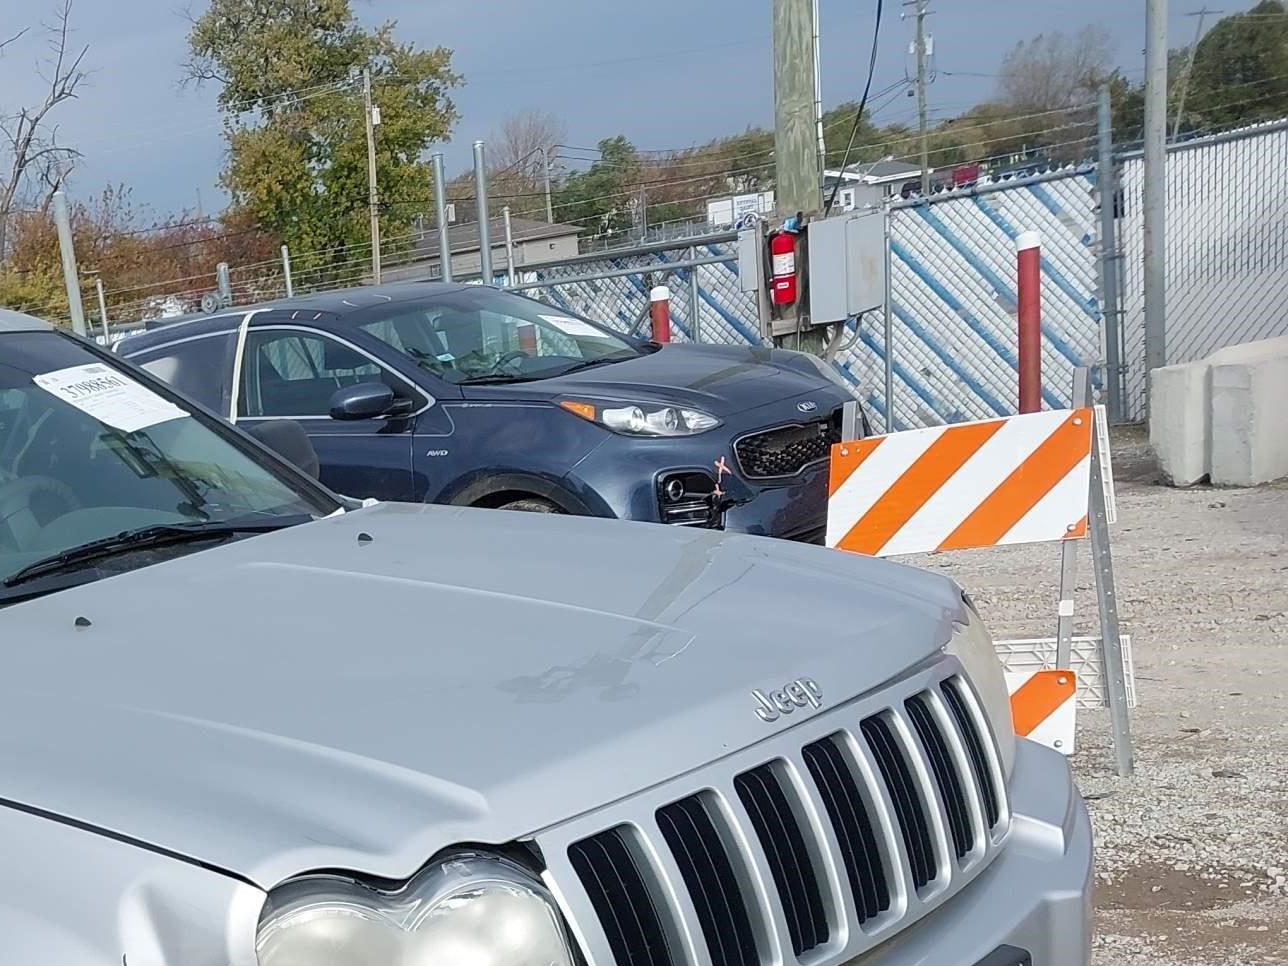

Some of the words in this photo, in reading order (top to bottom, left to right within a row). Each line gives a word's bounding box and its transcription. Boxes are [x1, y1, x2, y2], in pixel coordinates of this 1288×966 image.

[59, 375, 128, 399] 37988561
[426, 449, 448, 457] AWD
[751, 677, 823, 722] Jeep
